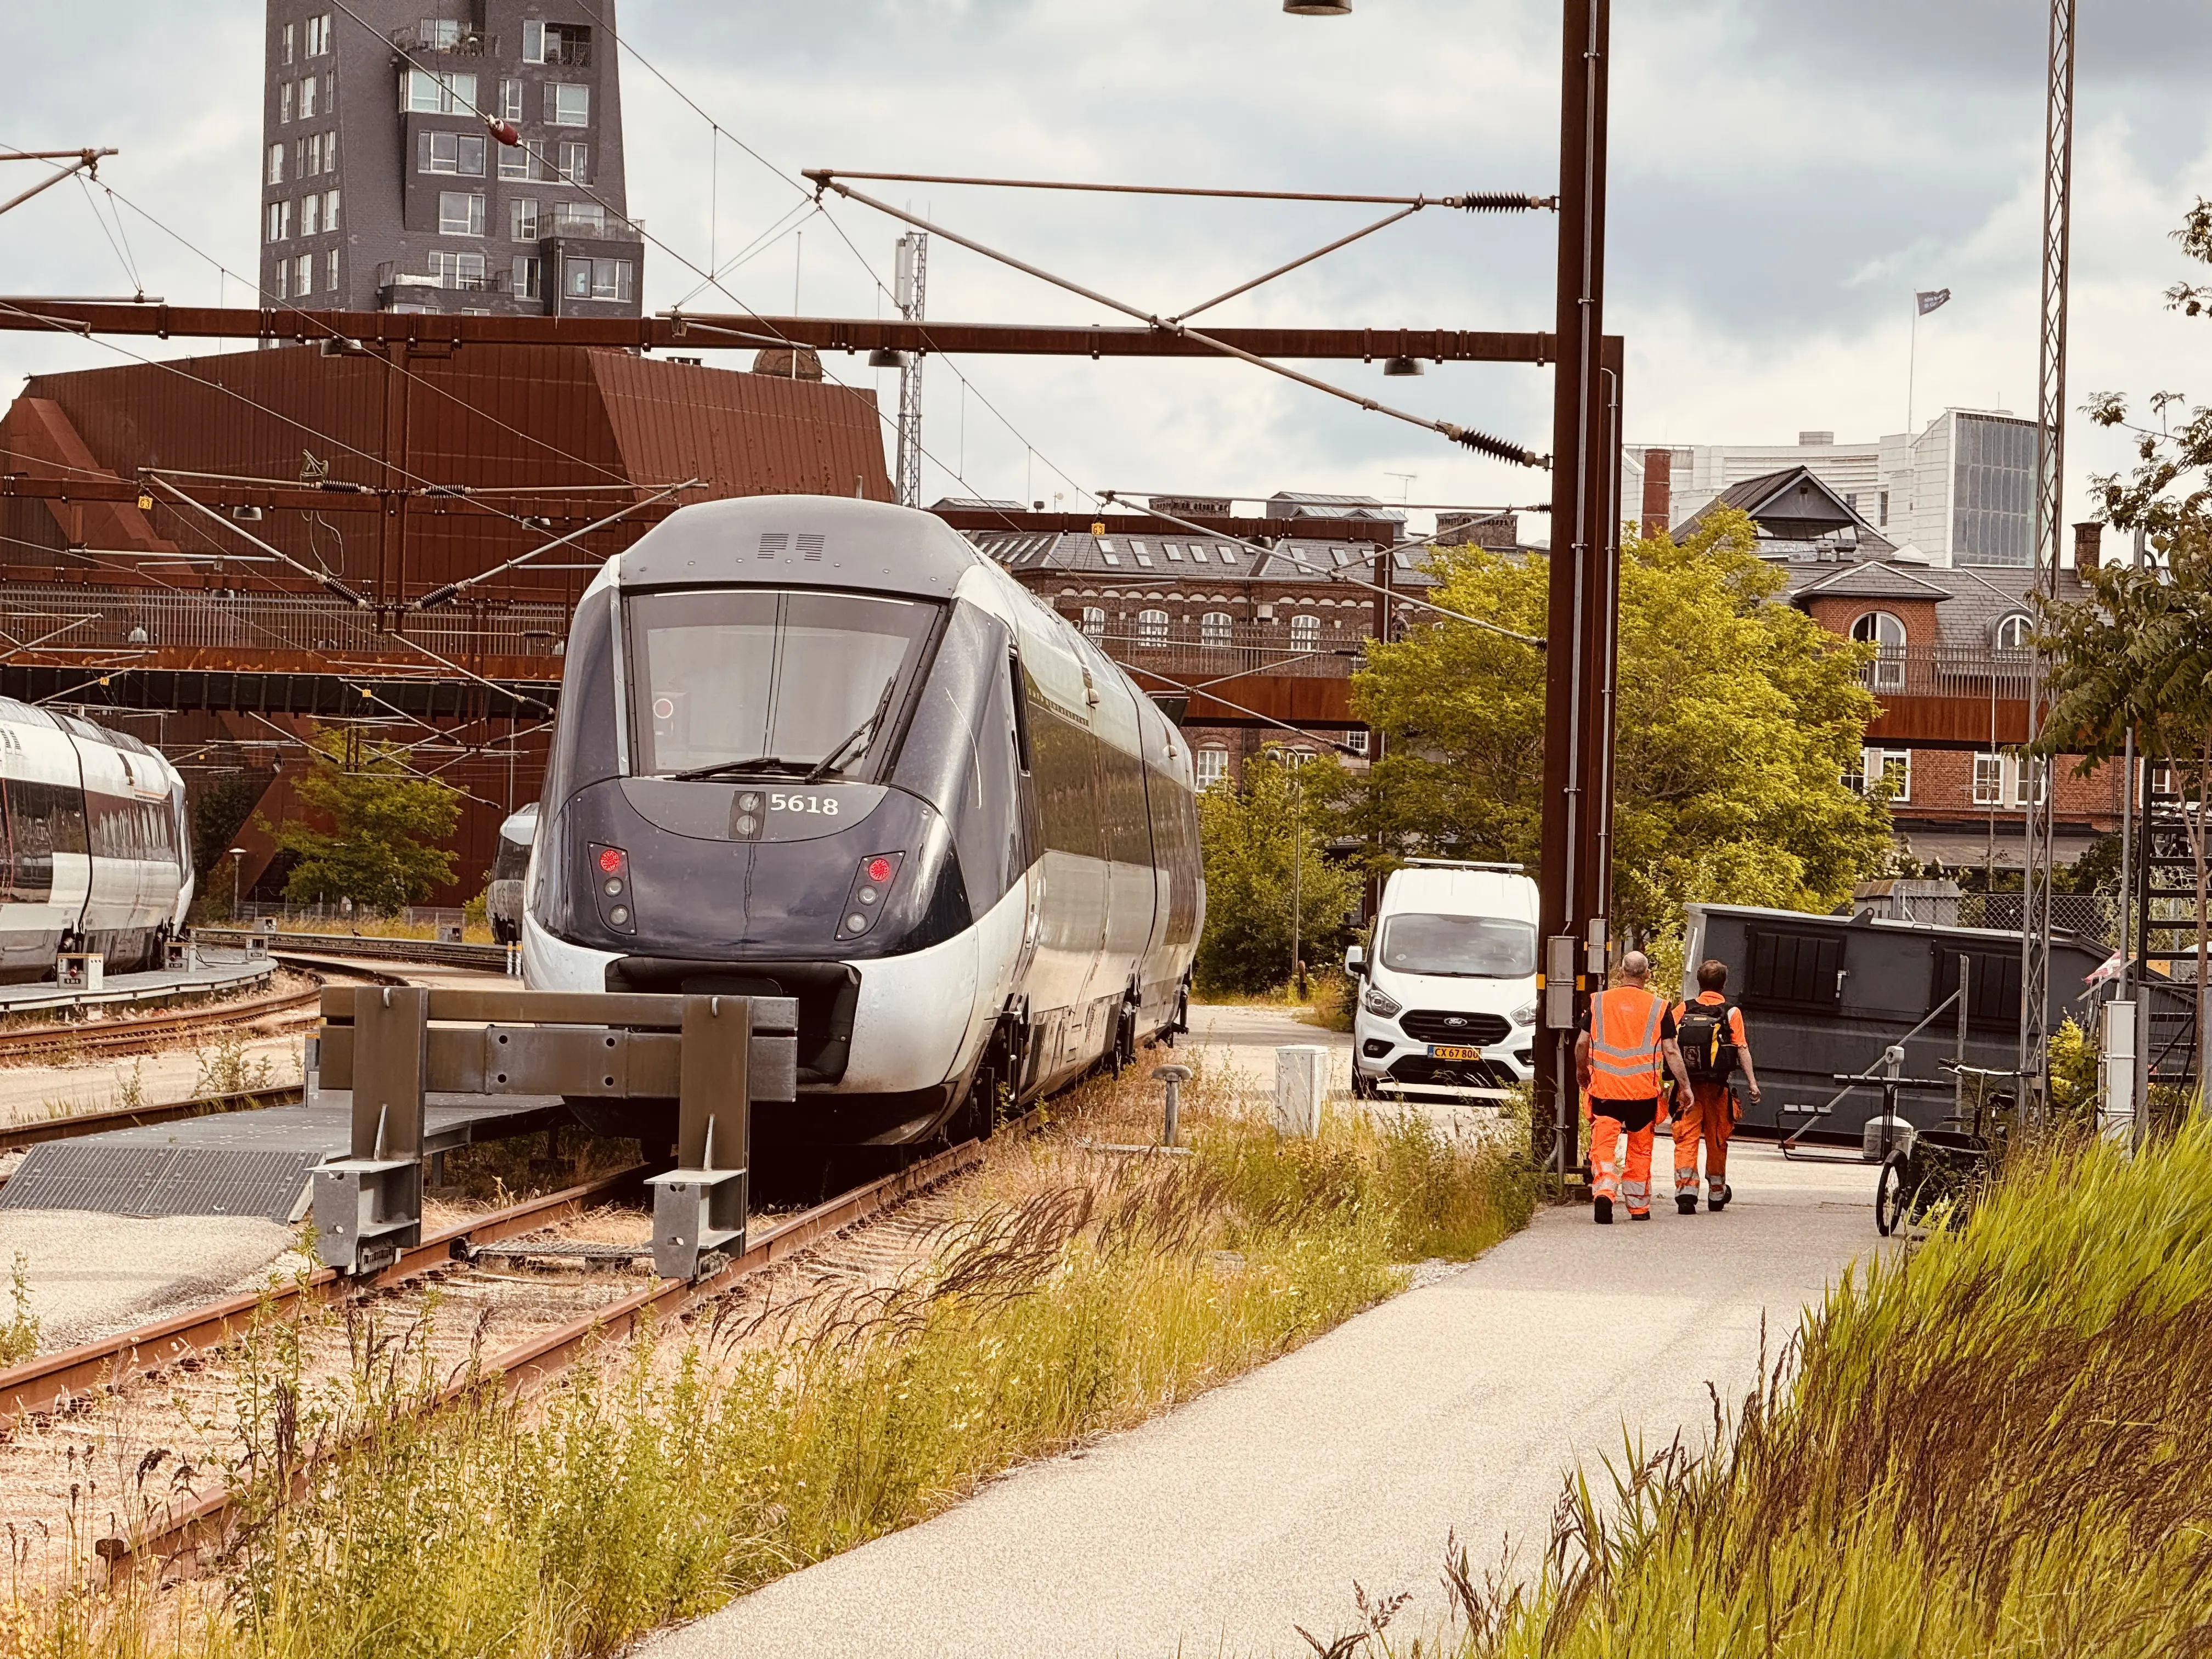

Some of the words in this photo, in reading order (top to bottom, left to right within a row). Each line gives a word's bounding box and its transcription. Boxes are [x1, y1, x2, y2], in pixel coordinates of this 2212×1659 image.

[770, 794, 839, 816] 5618
[1435, 1048, 1447, 1057] CX
[1449, 1049, 1460, 1058] 67
